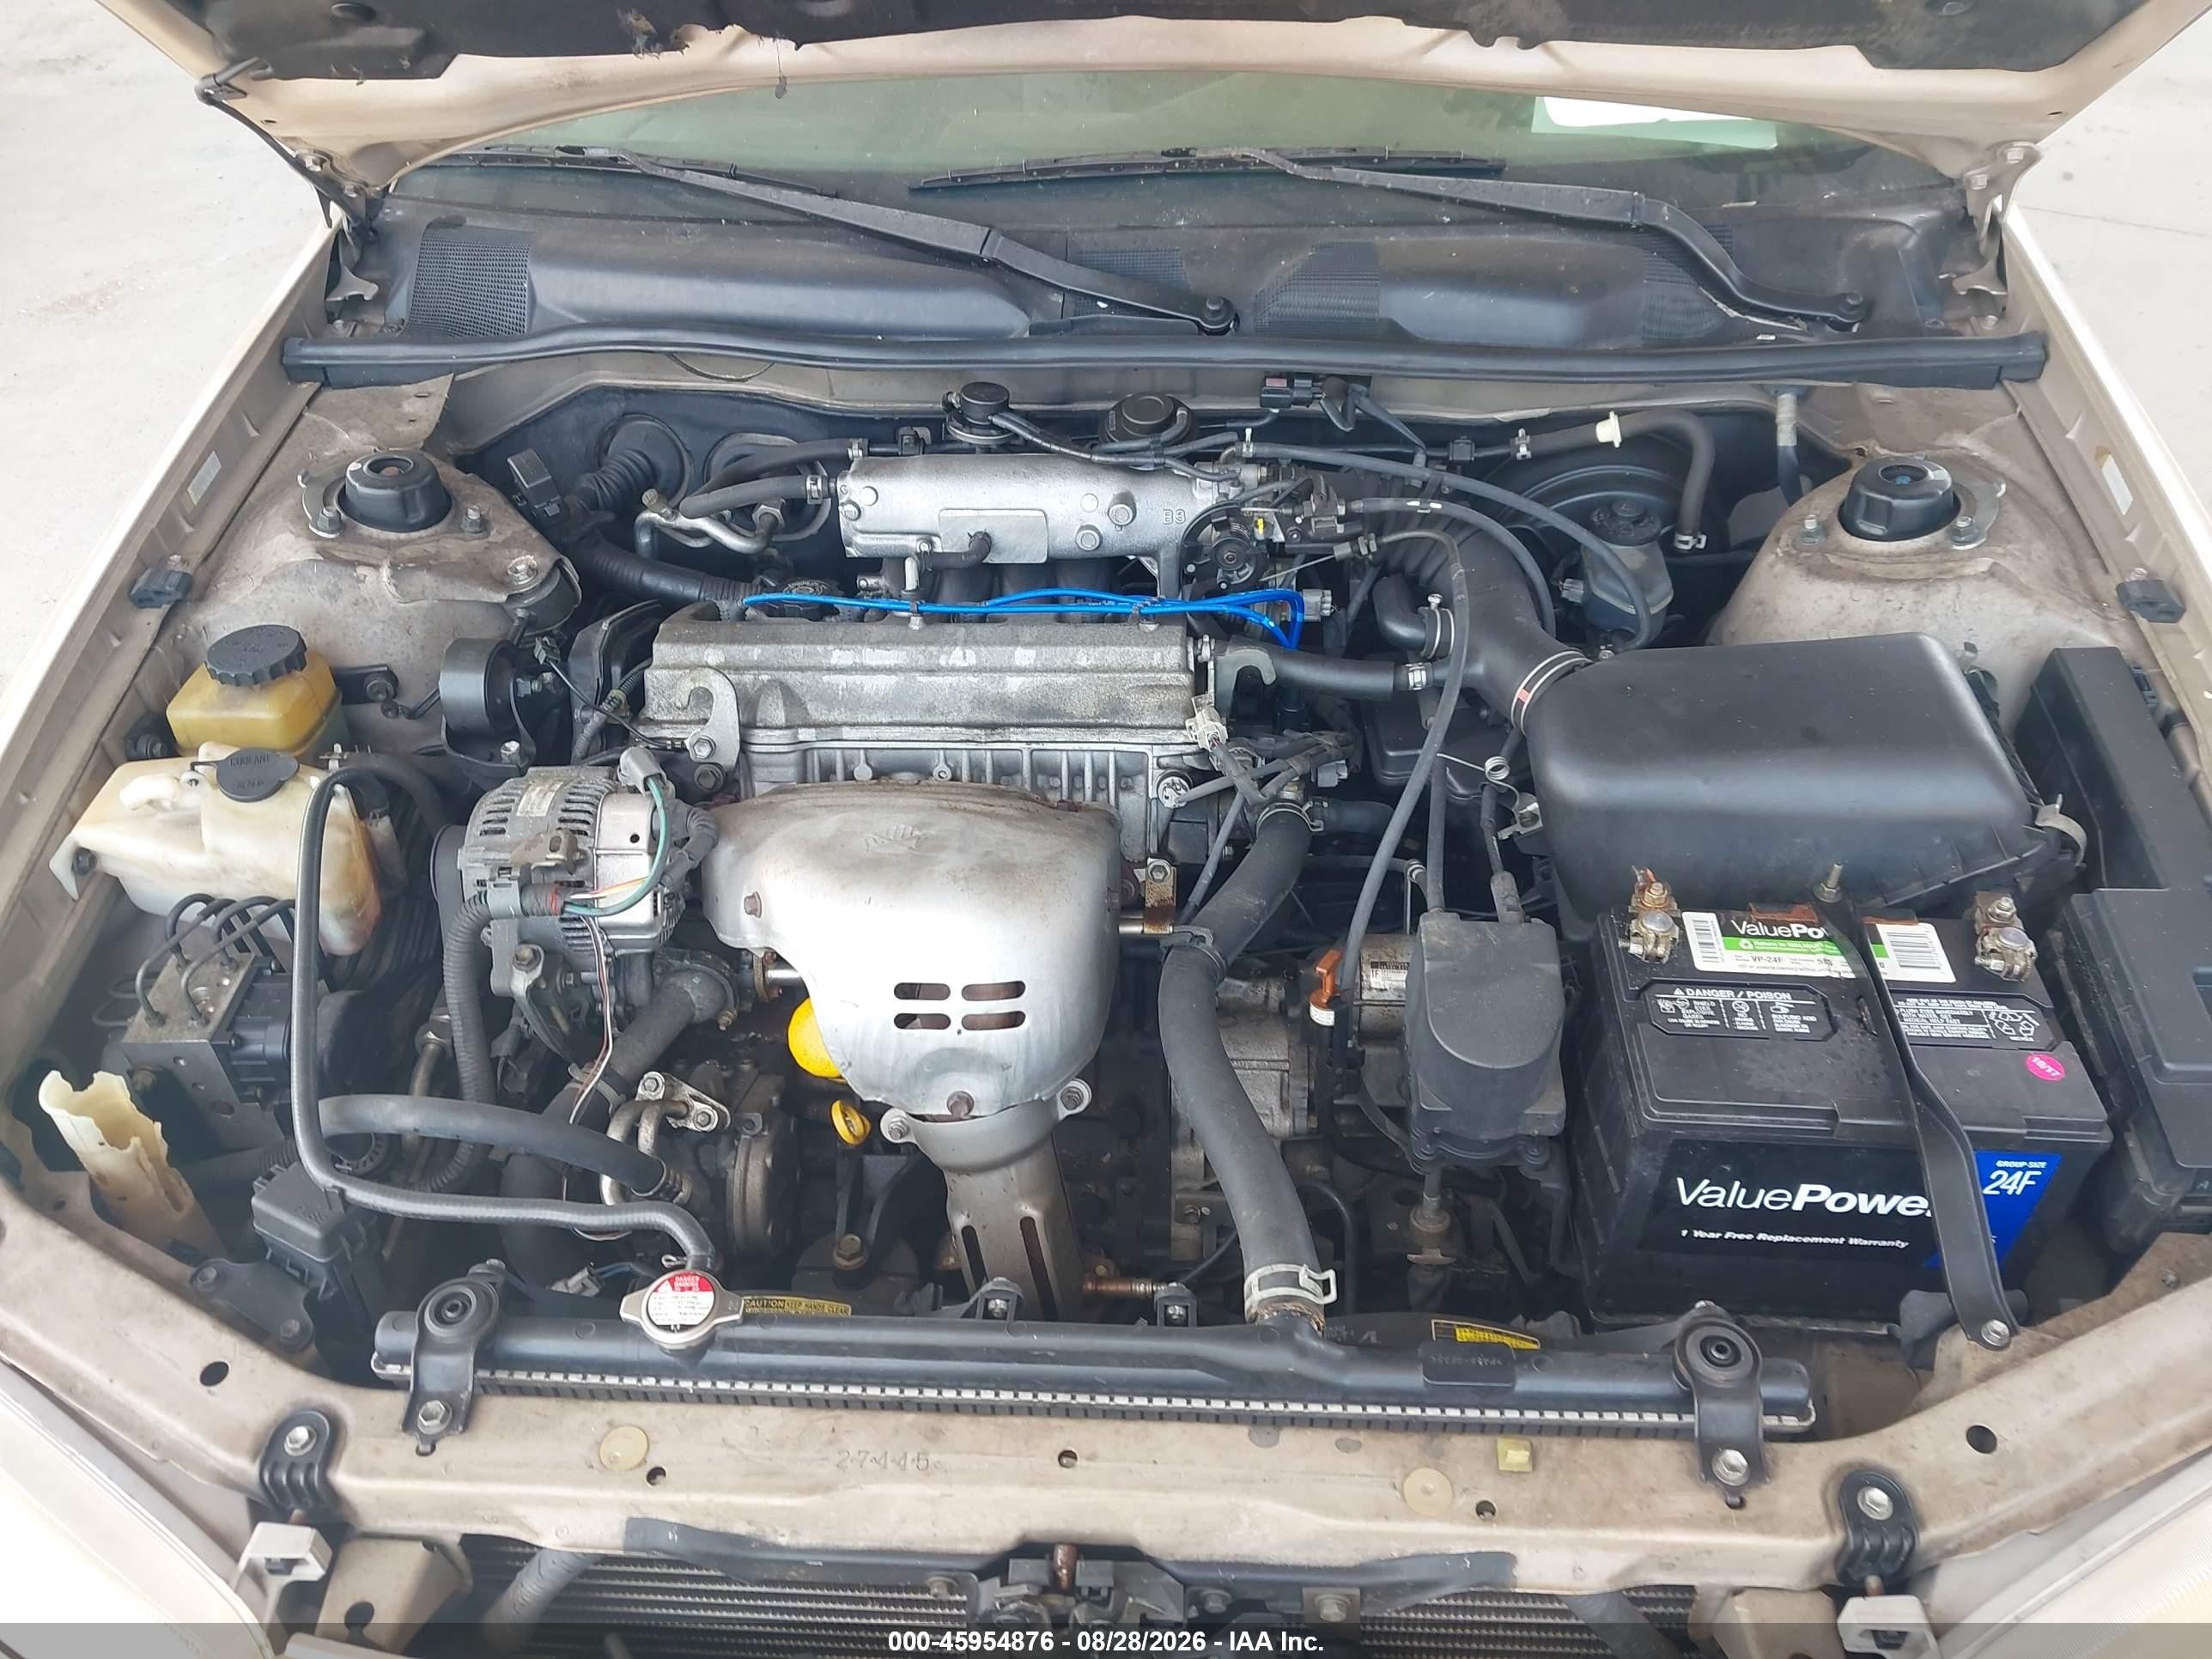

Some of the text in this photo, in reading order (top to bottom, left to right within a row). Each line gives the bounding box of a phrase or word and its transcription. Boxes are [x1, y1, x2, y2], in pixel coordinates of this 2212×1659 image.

[1162, 508, 1187, 525] B3
[1730, 920, 1829, 939] ValuePo
[1686, 988, 1735, 998] DANGER
[1747, 991, 1792, 1000] POISON
[1983, 1170, 2042, 1195] 24F
[1675, 1176, 1933, 1218] ValuePowe
[1692, 1230, 1723, 1239] Year
[1723, 1231, 1754, 1241] Free
[1755, 1232, 1845, 1245] Replacement
[1847, 1237, 1910, 1249] Warranty
